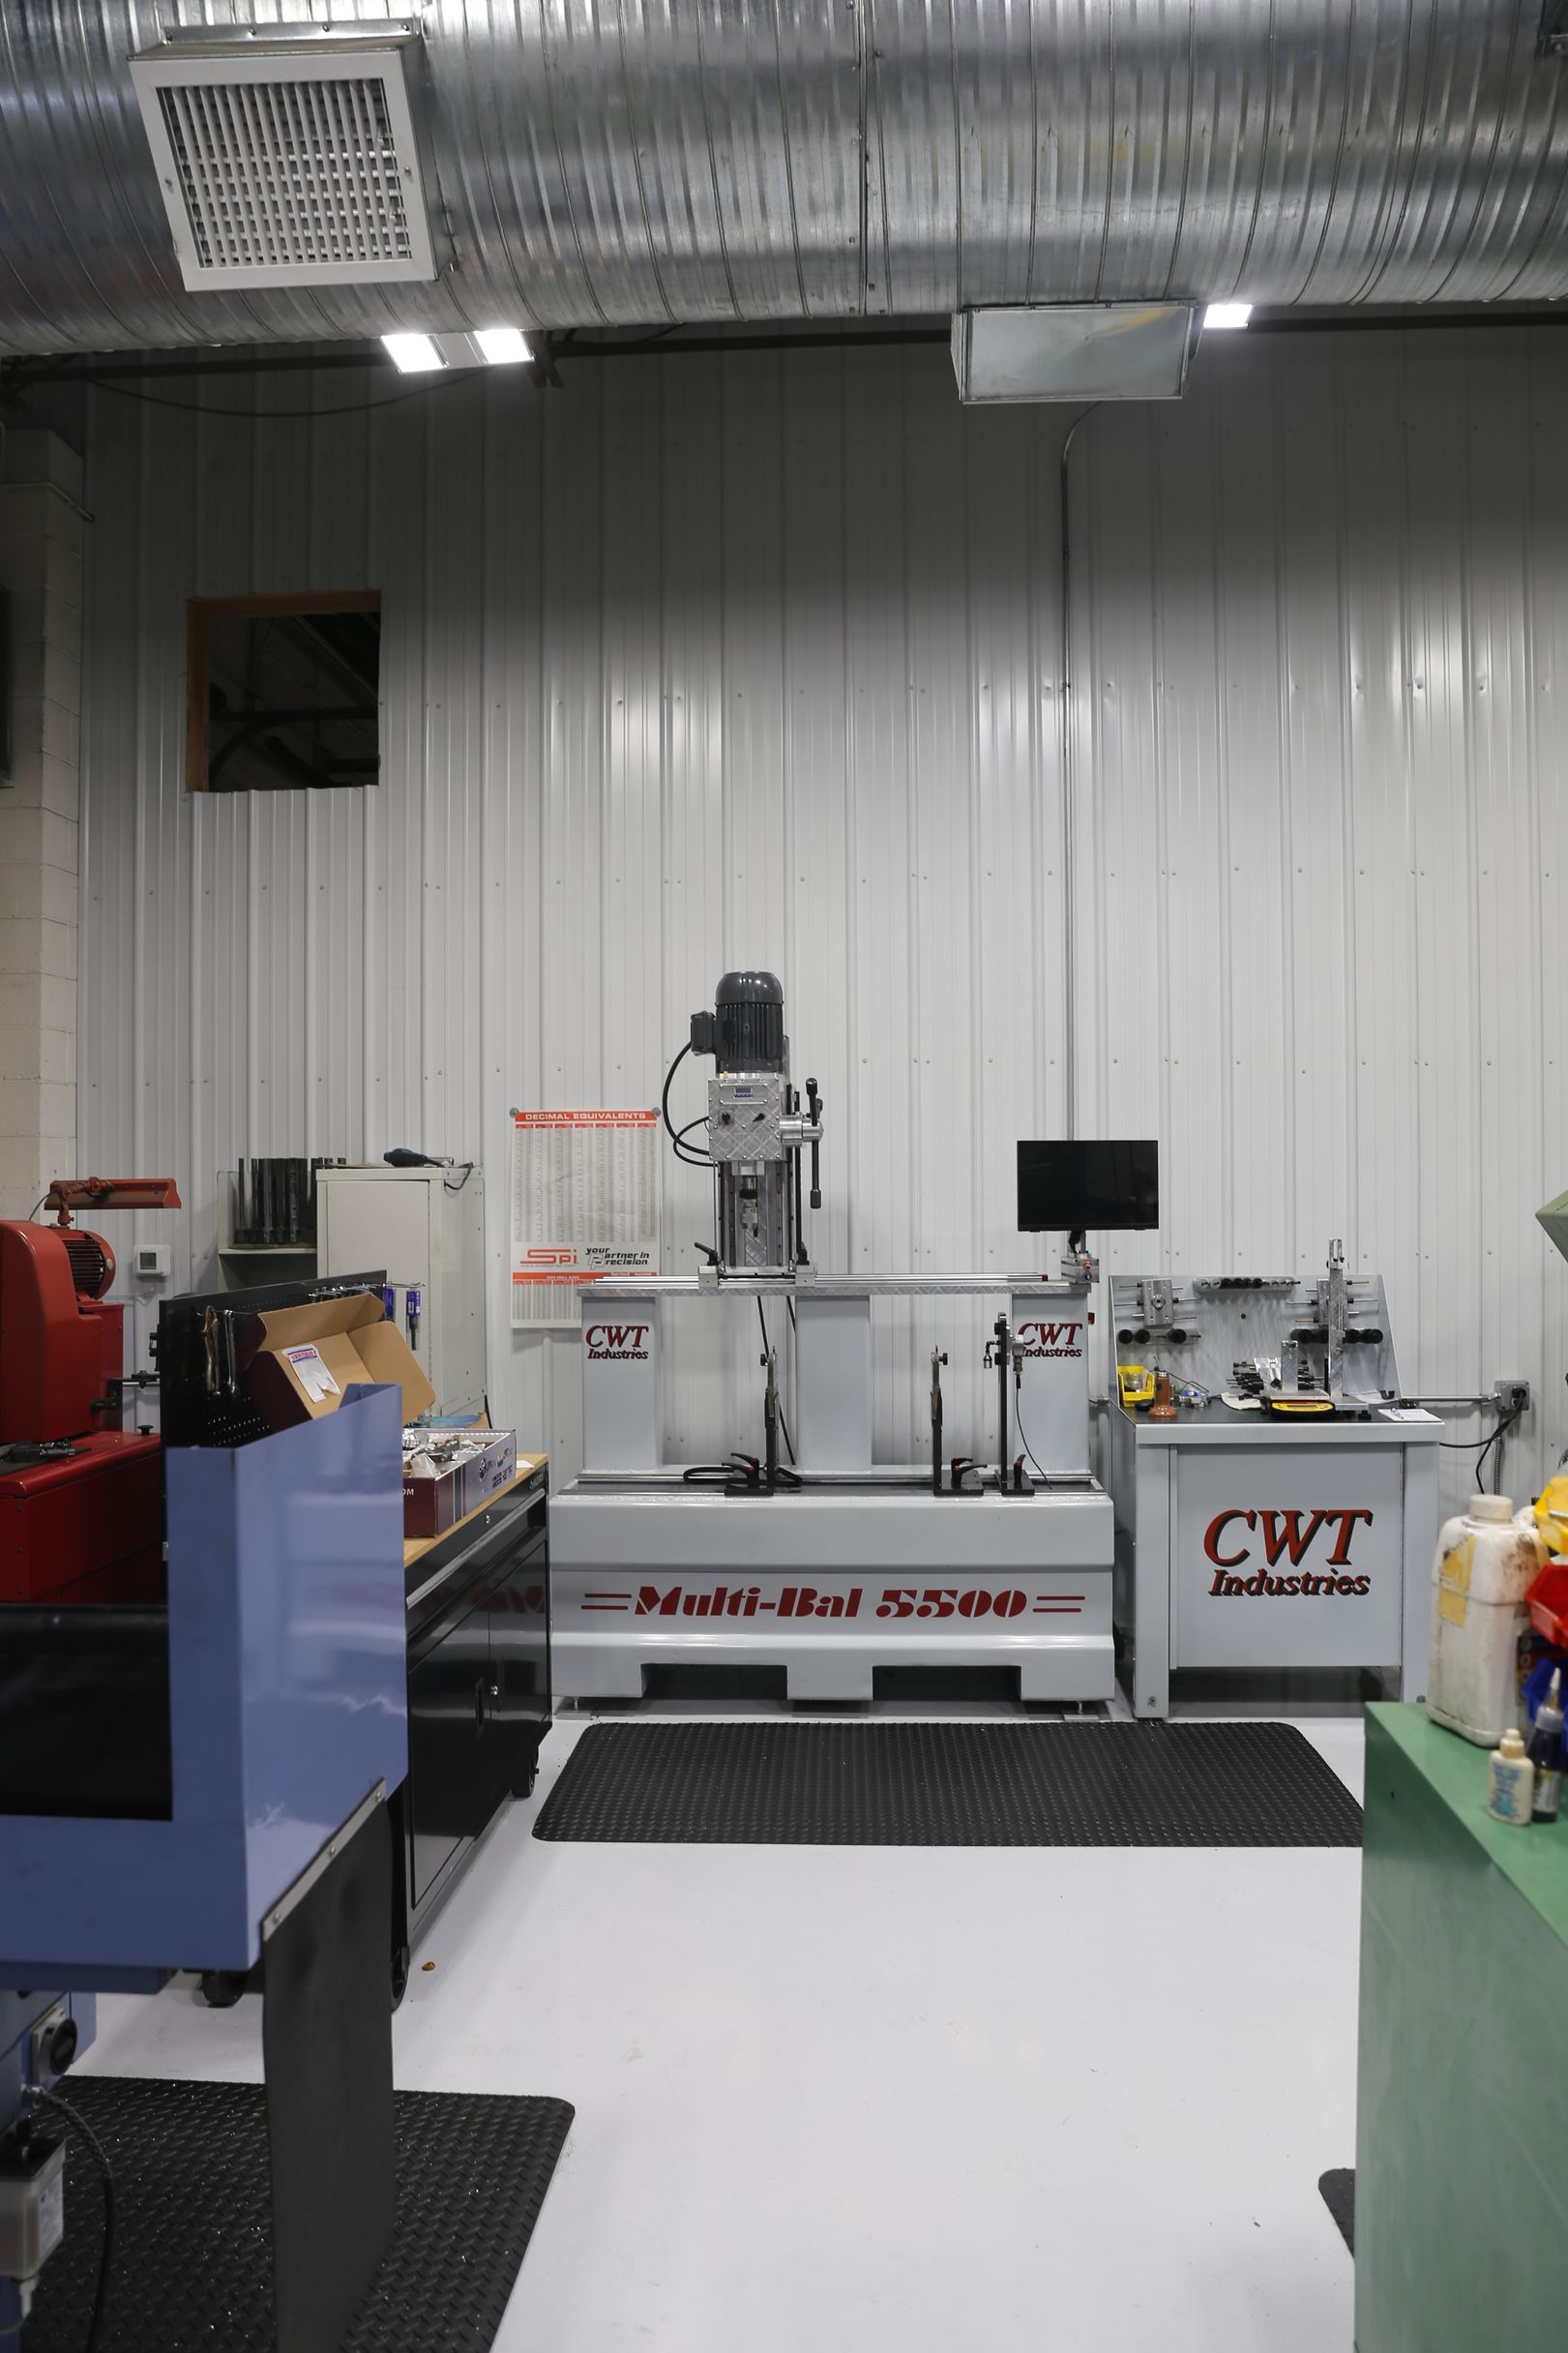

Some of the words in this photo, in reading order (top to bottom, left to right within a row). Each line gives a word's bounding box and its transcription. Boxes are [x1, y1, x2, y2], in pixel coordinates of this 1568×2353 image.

[585, 1247, 610, 1256] your
[585, 1325, 650, 1348] CWT
[1018, 1323, 1083, 1346] CWT
[587, 1348, 649, 1359] Industries
[1203, 1508, 1375, 1567] CWT
[1208, 1567, 1372, 1596] Industries
[634, 1586, 864, 1618] Multi-Bal
[874, 1589, 1028, 1619] 5500
